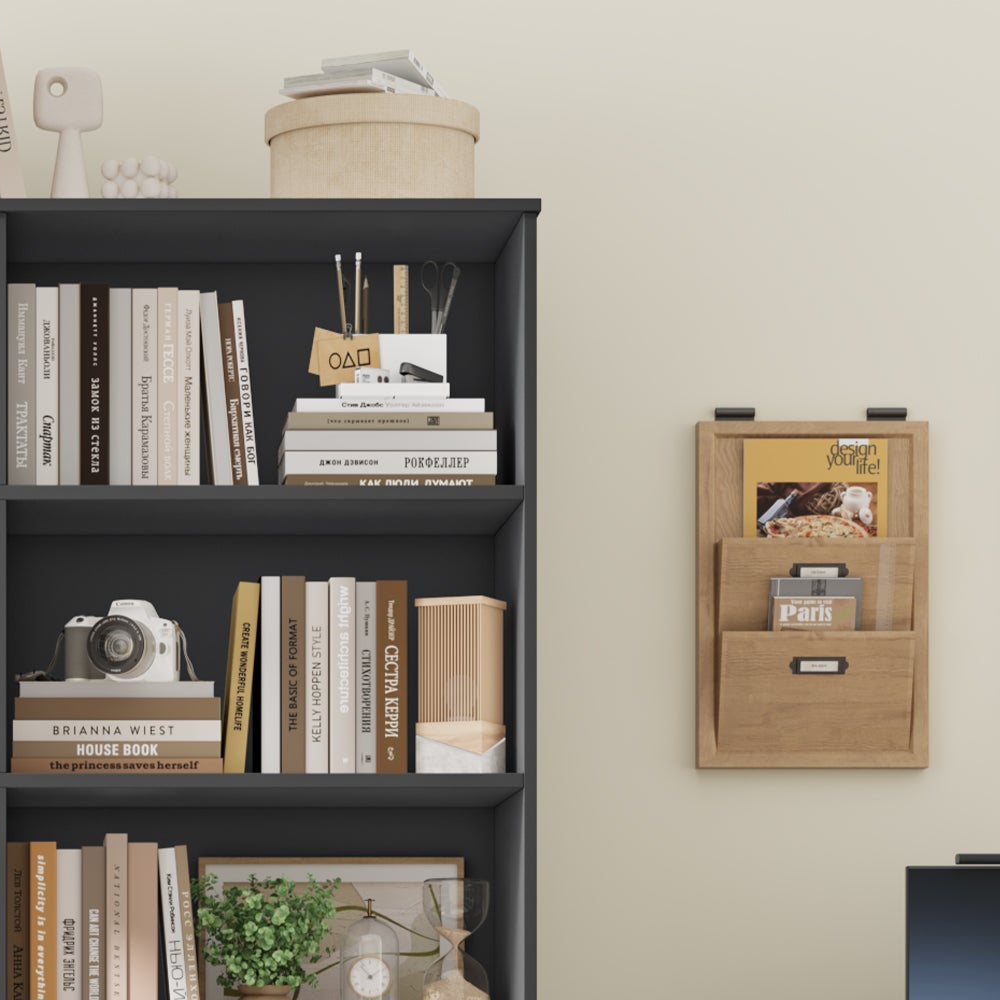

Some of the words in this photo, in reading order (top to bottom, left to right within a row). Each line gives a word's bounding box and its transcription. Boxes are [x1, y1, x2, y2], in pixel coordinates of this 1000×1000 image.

[42, 319, 51, 380] ДЖОВАНЬОЛИ
[137, 375, 153, 413] Братья
[183, 376, 193, 429] Маленькие
[239, 367, 252, 419] ГОВОРИ
[15, 400, 28, 468] ТРАКТАТЫ
[38, 414, 55, 467] Спартак
[137, 414, 152, 480] Карамазовы
[244, 422, 255, 444] КАК
[828, 440, 878, 458] design
[183, 430, 192, 477] женщины
[246, 446, 257, 466] БОГ
[319, 459, 342, 467] ДЖОН
[344, 459, 379, 467] ДЭВИСОН
[404, 457, 470, 470] РОКФЕЛЛЕР
[826, 452, 857, 471] your
[855, 456, 880, 475] life!
[779, 604, 833, 622] Paris
[240, 622, 251, 649] CREATE
[288, 617, 298, 660] FORMAT
[311, 625, 322, 659] STYLE
[236, 650, 249, 694] WONDERFUL
[288, 663, 298, 677] OF
[311, 661, 322, 706] HOPPEN
[384, 645, 399, 694] СЕСТРА
[288, 680, 298, 710] BASIC
[360, 649, 371, 734] СТИХОТВОРЕНИЯ
[52, 725, 122, 736] BRIANNA
[130, 725, 176, 736] WIEST
[233, 695, 244, 732] HOMELIFE
[288, 712, 298, 732] THE
[311, 709, 322, 743] KELLY
[384, 697, 399, 738] КЕРРИ
[77, 743, 119, 757] HOUSE
[123, 743, 159, 757] BOOK
[35, 854, 47, 912] simplicity
[113, 863, 121, 936] NATIONAL
[37, 916, 46, 926] is
[88, 908, 100, 922] CAN
[88, 923, 100, 936] ART
[37, 929, 46, 941] in
[62, 917, 76, 956] ФРИДРИХ
[88, 937, 100, 964] CHANGE
[62, 957, 75, 992] ЭНГЕЛЬС
[88, 964, 100, 977] THE
